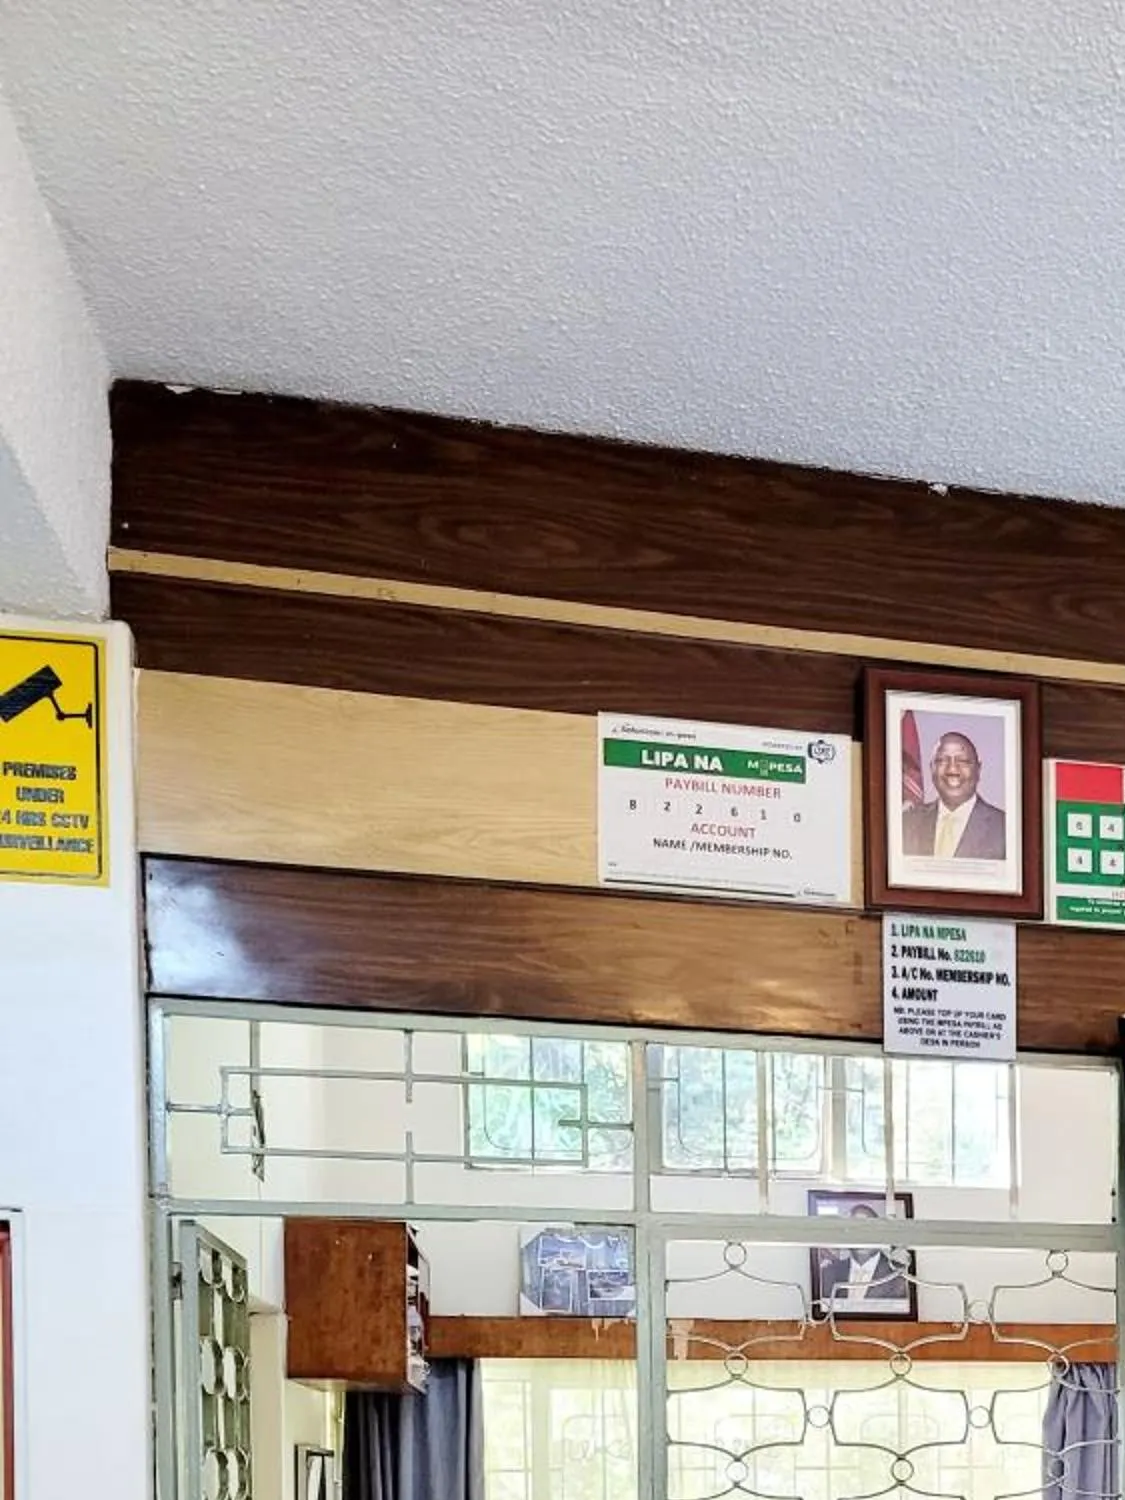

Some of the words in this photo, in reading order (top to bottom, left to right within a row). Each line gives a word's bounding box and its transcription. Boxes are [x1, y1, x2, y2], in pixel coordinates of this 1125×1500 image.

[641, 749, 689, 768] LIPA
[694, 755, 724, 772] NA
[3, 761, 77, 781] PREMISES
[16, 786, 64, 804] UNDER
[665, 778, 717, 794] PAYBILL
[722, 783, 781, 800] NUMBER
[0, 808, 11, 825] 4
[51, 812, 89, 830] CCTV
[629, 799, 637, 810] 8
[663, 801, 671, 812] 2
[695, 803, 703, 815] 2
[731, 806, 738, 817] 6
[760, 808, 767, 820] 1
[794, 812, 801, 823] 0
[691, 823, 755, 839] ACCOUNT
[0, 833, 94, 853] URVEILLANCE
[653, 838, 687, 851] NAME
[901, 923, 920, 938] LIPA
[922, 925, 935, 939] NA
[901, 945, 936, 961] PAYBILL
[936, 969, 993, 985] MEMBERSHIP
[902, 986, 938, 1002] AMOUNT
